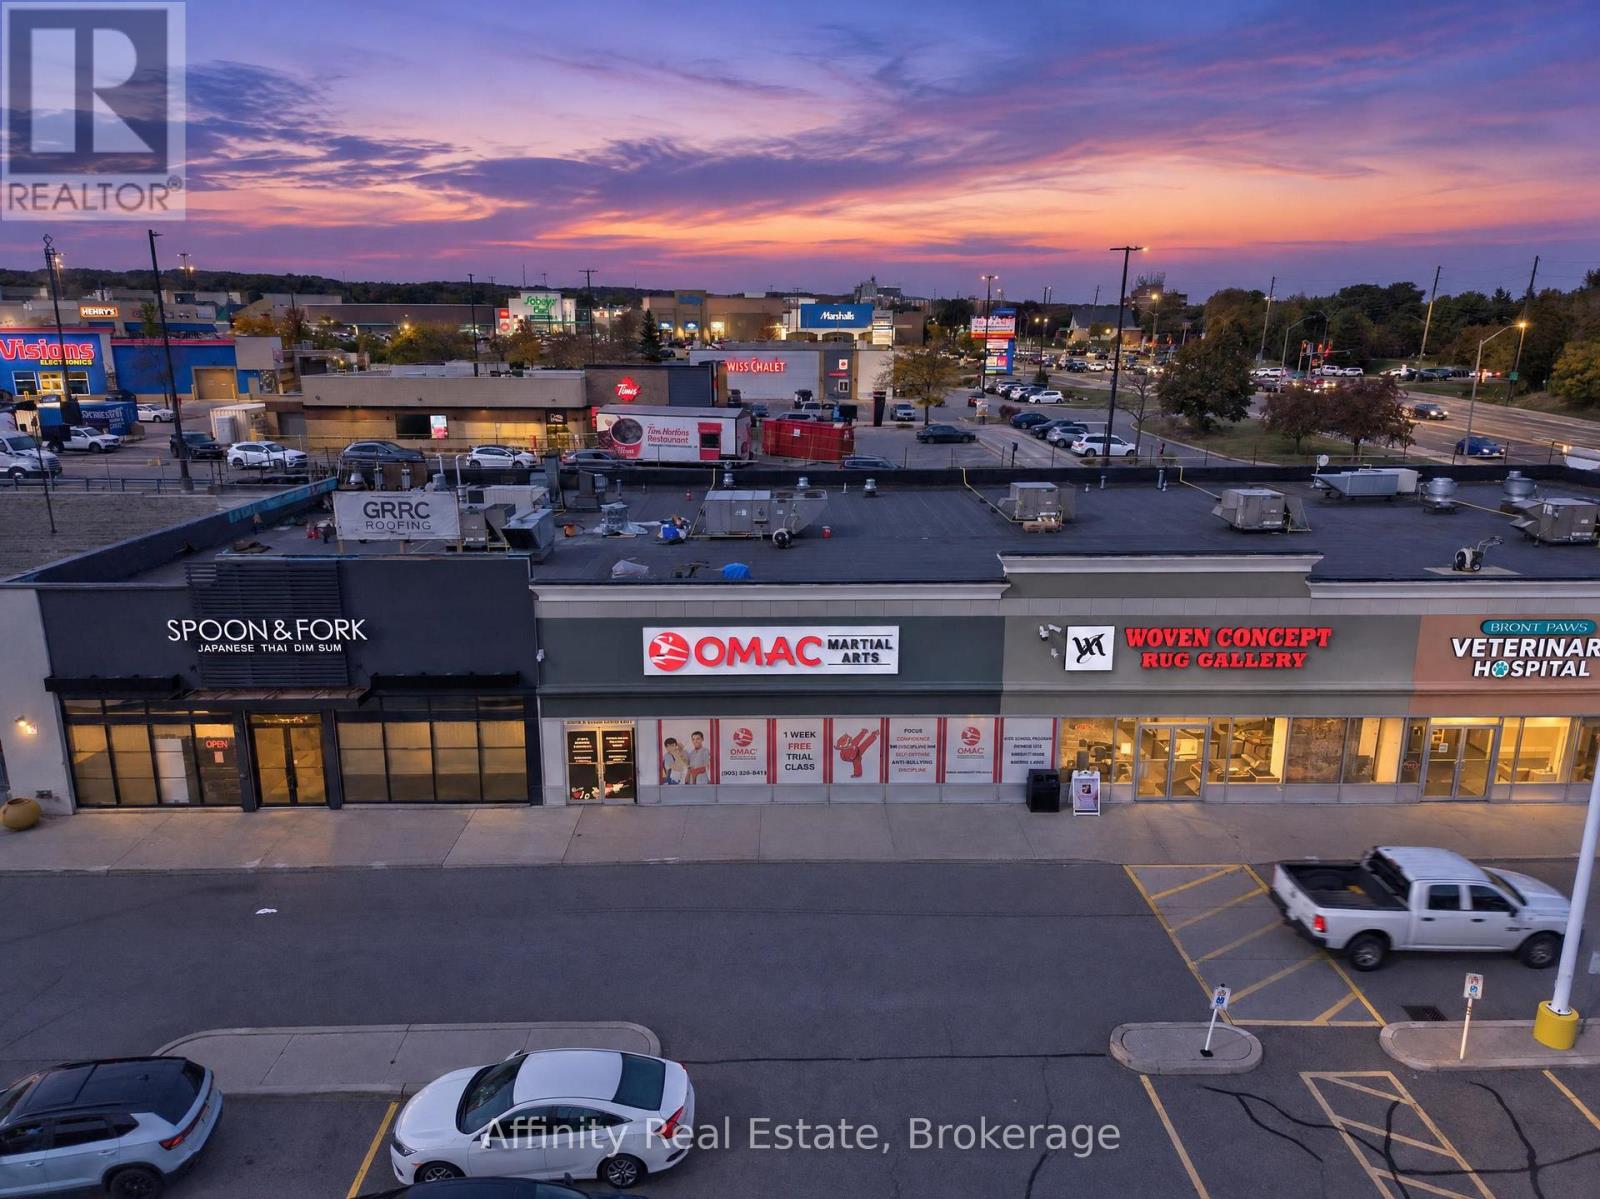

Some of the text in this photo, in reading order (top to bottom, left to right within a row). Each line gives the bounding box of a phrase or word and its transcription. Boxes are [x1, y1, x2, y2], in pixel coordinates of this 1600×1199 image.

[82, 307, 115, 316] HENRY'S
[820, 311, 855, 321] Marshalls
[0, 338, 95, 360] Visions
[726, 357, 786, 373] WISS CHALET
[616, 383, 639, 396] Tims
[662, 427, 690, 437] Hortons
[647, 435, 690, 444] Restaurant
[362, 501, 432, 520] GRRC
[365, 520, 432, 531] ROOFING
[1489, 622, 1589, 633] BRONT PAWS
[1124, 627, 1333, 649] WOVEN CONCEPT
[197, 643, 342, 653] JAPANESE THAI DIM SUM
[827, 638, 894, 651] MARTIAL
[1451, 637, 1600, 658] VETERINAR
[694, 636, 824, 668] OMAC
[841, 651, 881, 664] ARTS
[1140, 651, 1308, 669] RUG GALLERY
[790, 731, 816, 739] WEEK
[205, 739, 229, 749] OPEN
[788, 742, 812, 750] FREE
[730, 748, 756, 756] OMAC
[957, 747, 984, 755] OMAC
[786, 753, 813, 761] TRIAL
[784, 763, 816, 771] CLASS
